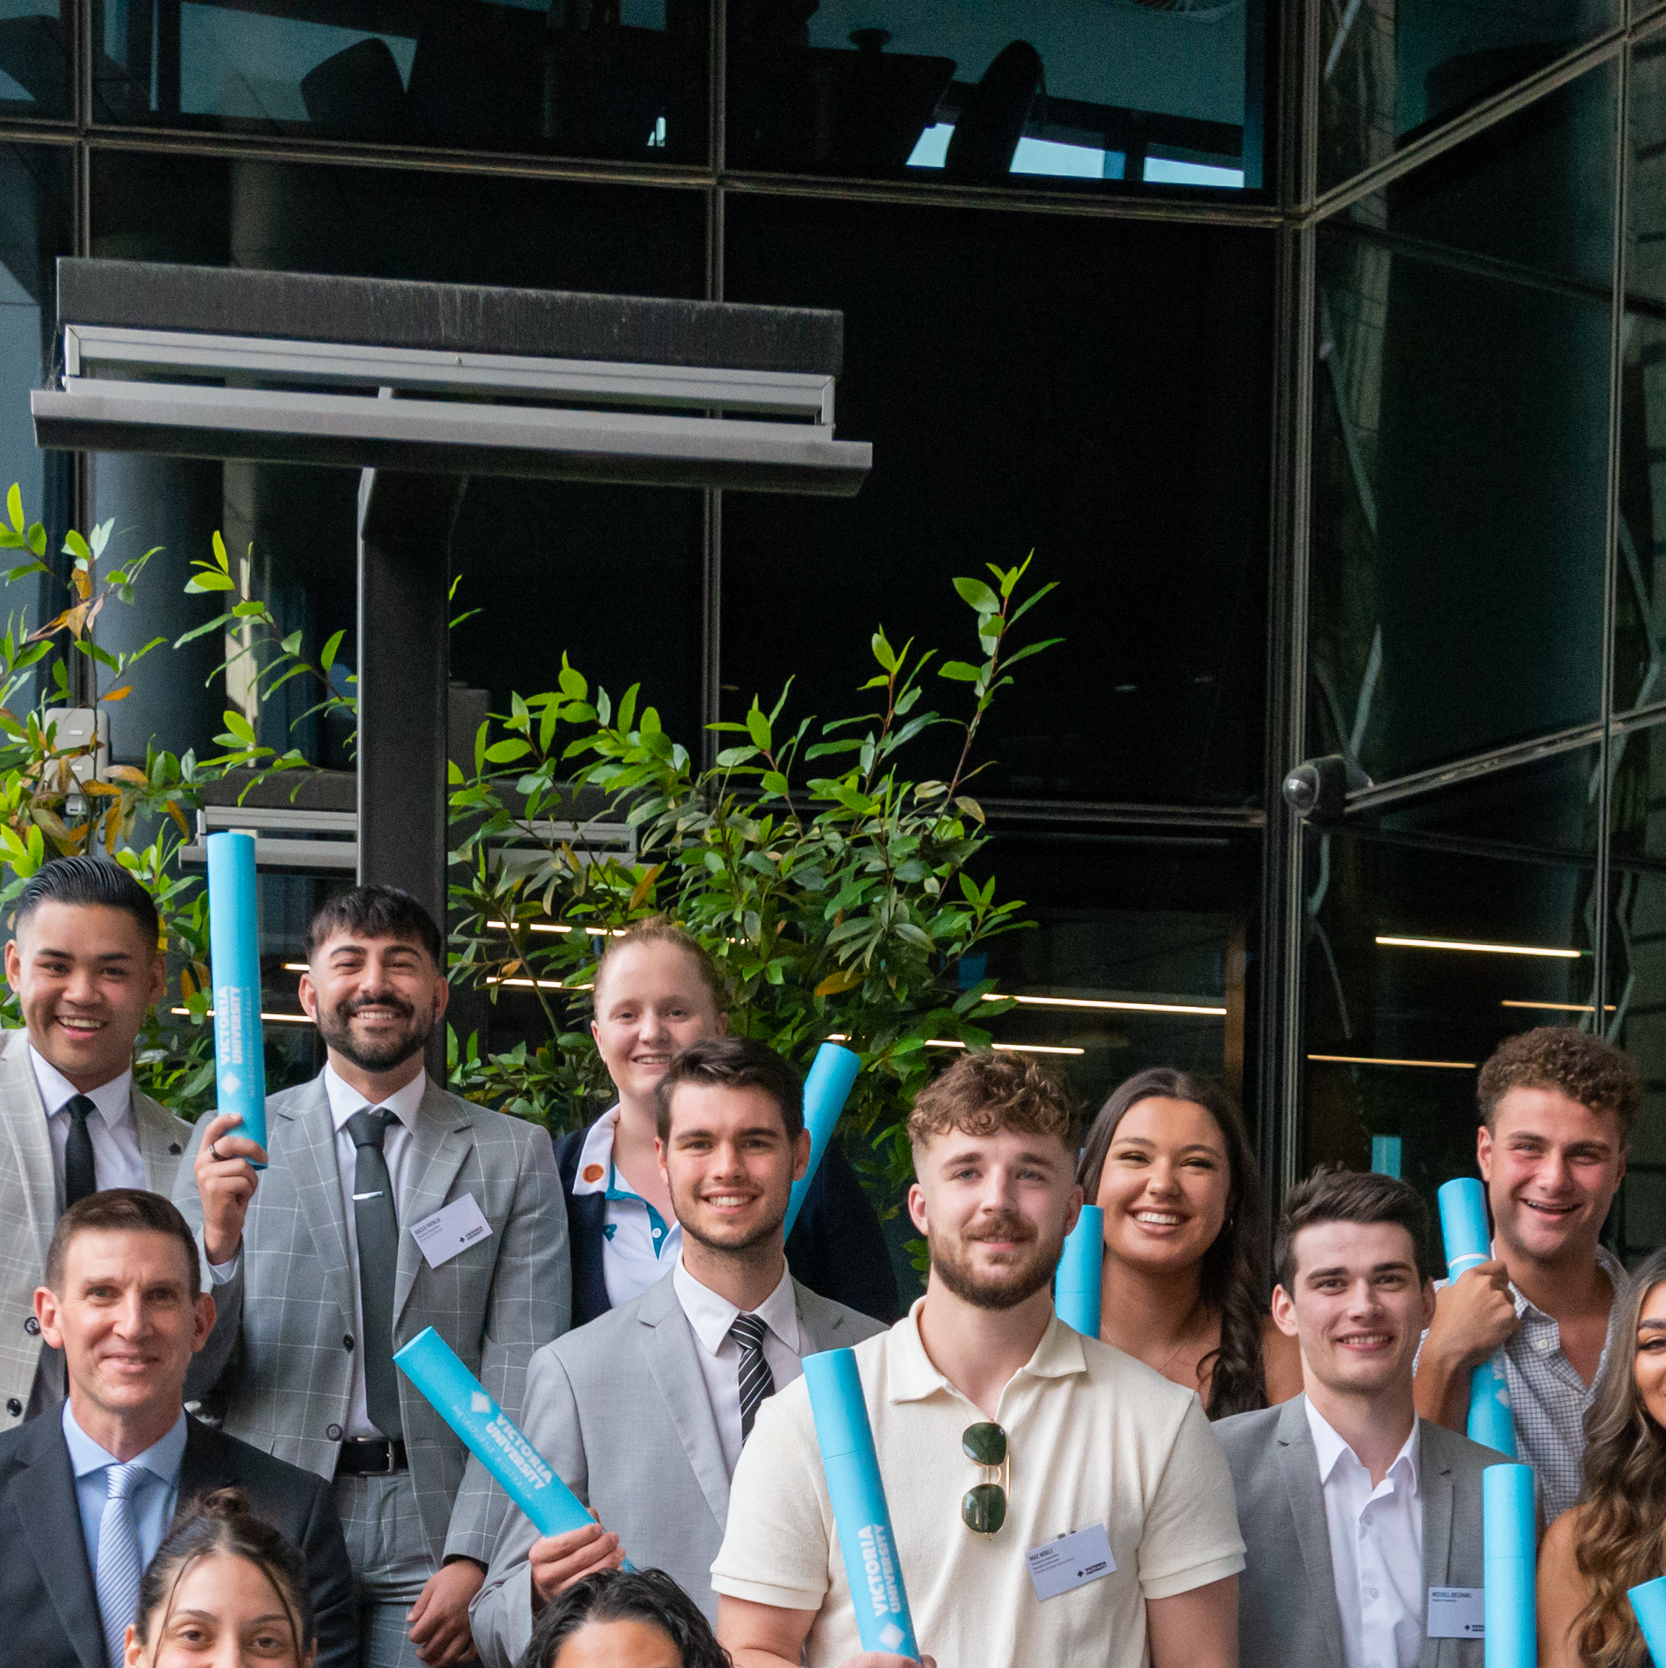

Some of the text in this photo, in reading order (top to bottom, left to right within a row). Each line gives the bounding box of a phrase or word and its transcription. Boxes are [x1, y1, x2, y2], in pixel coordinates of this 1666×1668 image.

[218, 985, 230, 1065] VICTORIA
[229, 985, 242, 1064] UNIVERSITY
[486, 1421, 546, 1490] UNIVERSITY
[496, 1413, 552, 1484] VICTORIA
[858, 1525, 888, 1617] VICTORIA
[873, 1523, 901, 1613] UNIVERSITY
